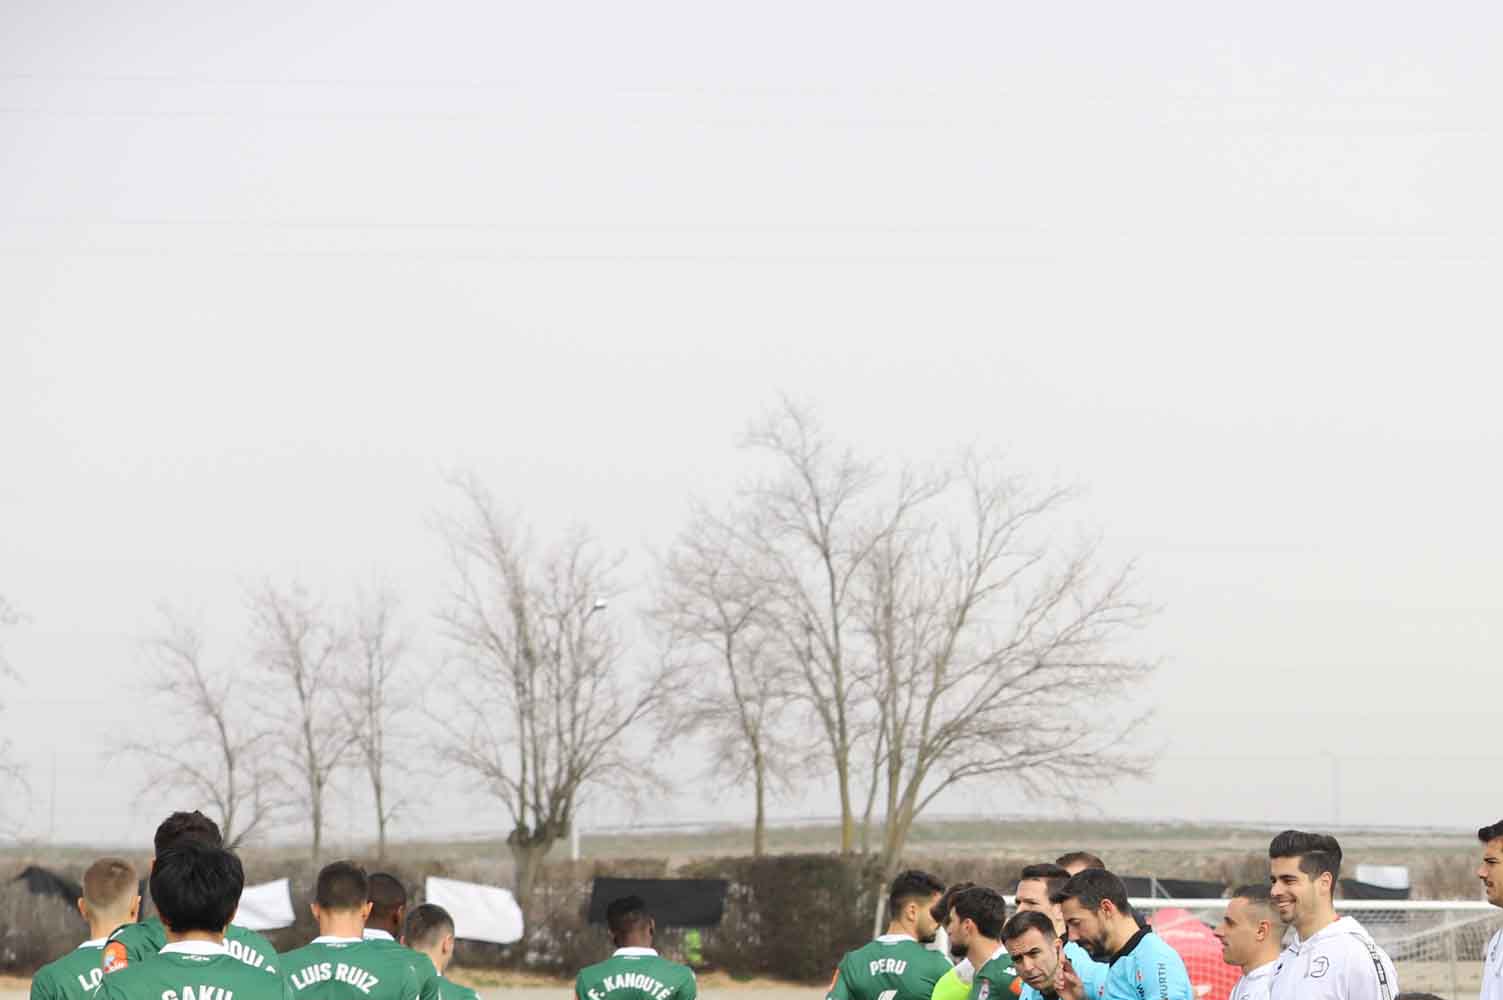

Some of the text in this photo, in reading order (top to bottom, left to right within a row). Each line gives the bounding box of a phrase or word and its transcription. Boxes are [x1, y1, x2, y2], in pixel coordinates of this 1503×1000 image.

[291, 963, 379, 994] LUIS RUIZ
[869, 958, 907, 976] PERU
